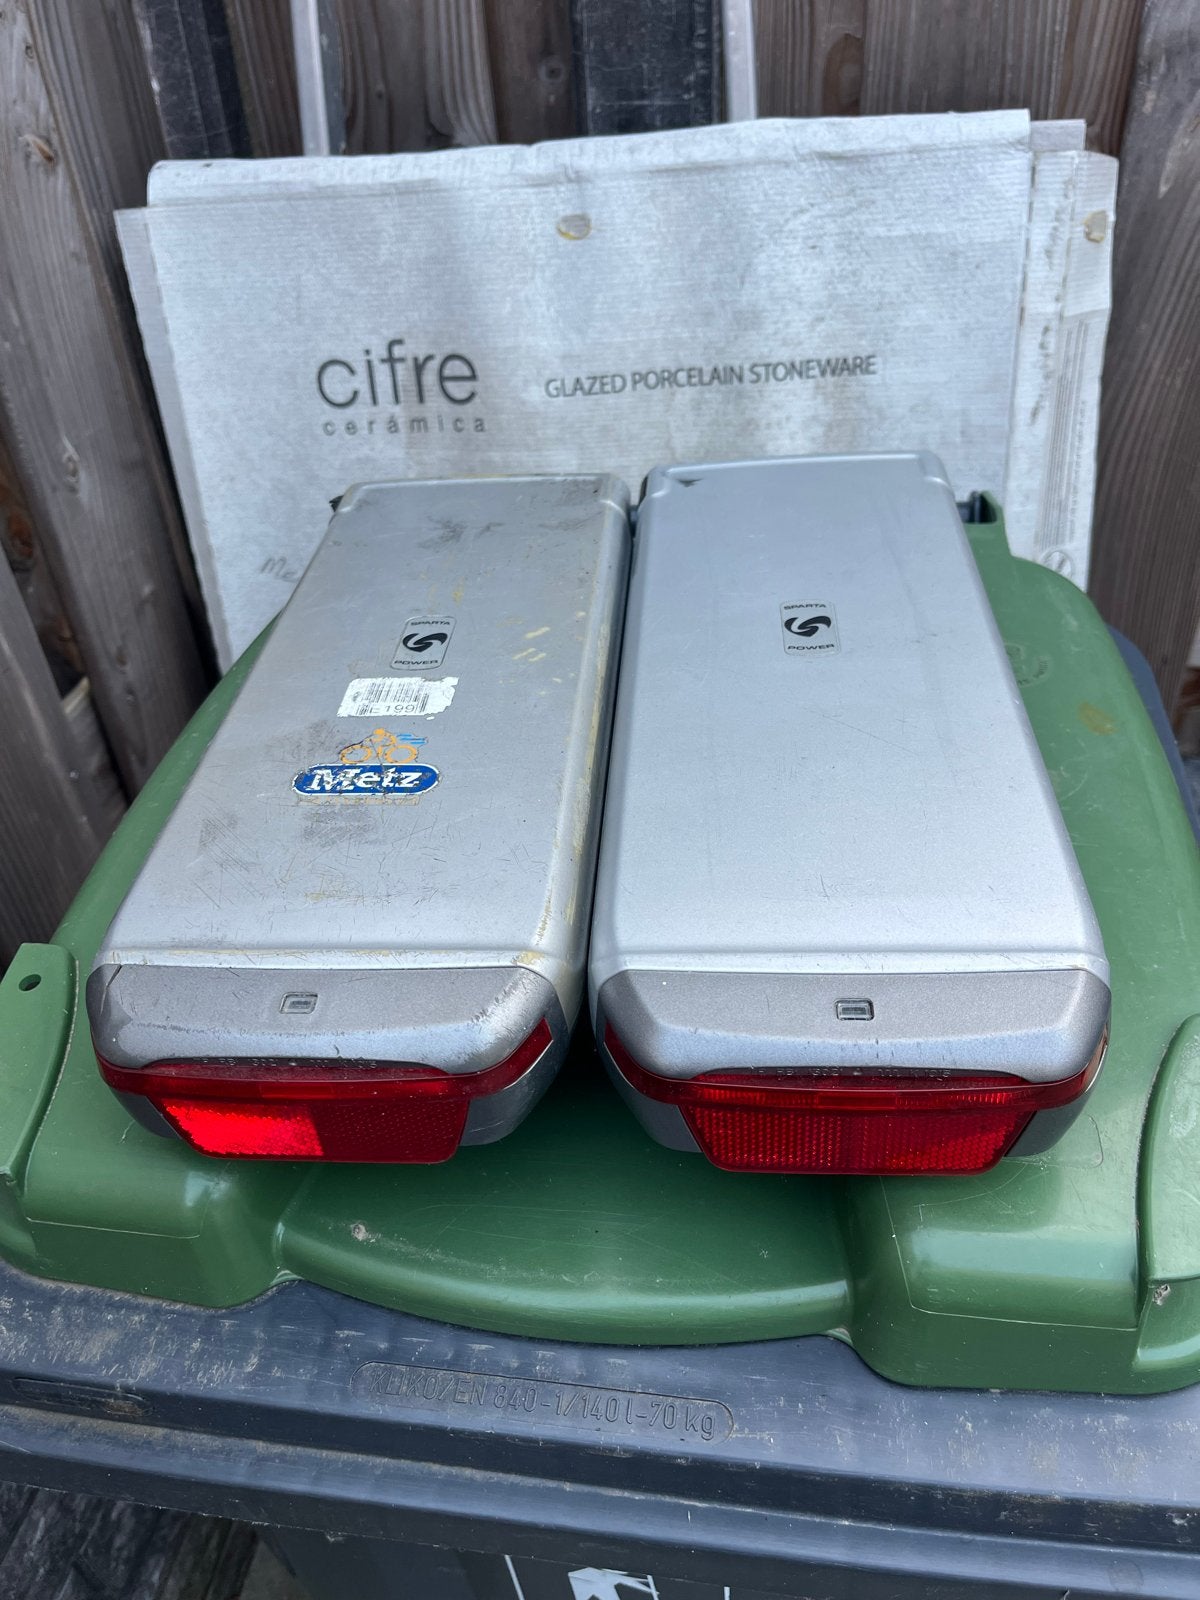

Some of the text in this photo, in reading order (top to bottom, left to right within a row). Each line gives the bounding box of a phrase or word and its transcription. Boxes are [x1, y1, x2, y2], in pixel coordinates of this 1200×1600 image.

[317, 338, 478, 409] cifre
[544, 354, 877, 399] GLAZED PORCELAIN STONEWARE
[323, 414, 486, 437] cerámica
[783, 603, 827, 611] SPARTA
[787, 643, 835, 651] POWER
[304, 766, 422, 792] Metz
[685, 1405, 716, 1441] kg
